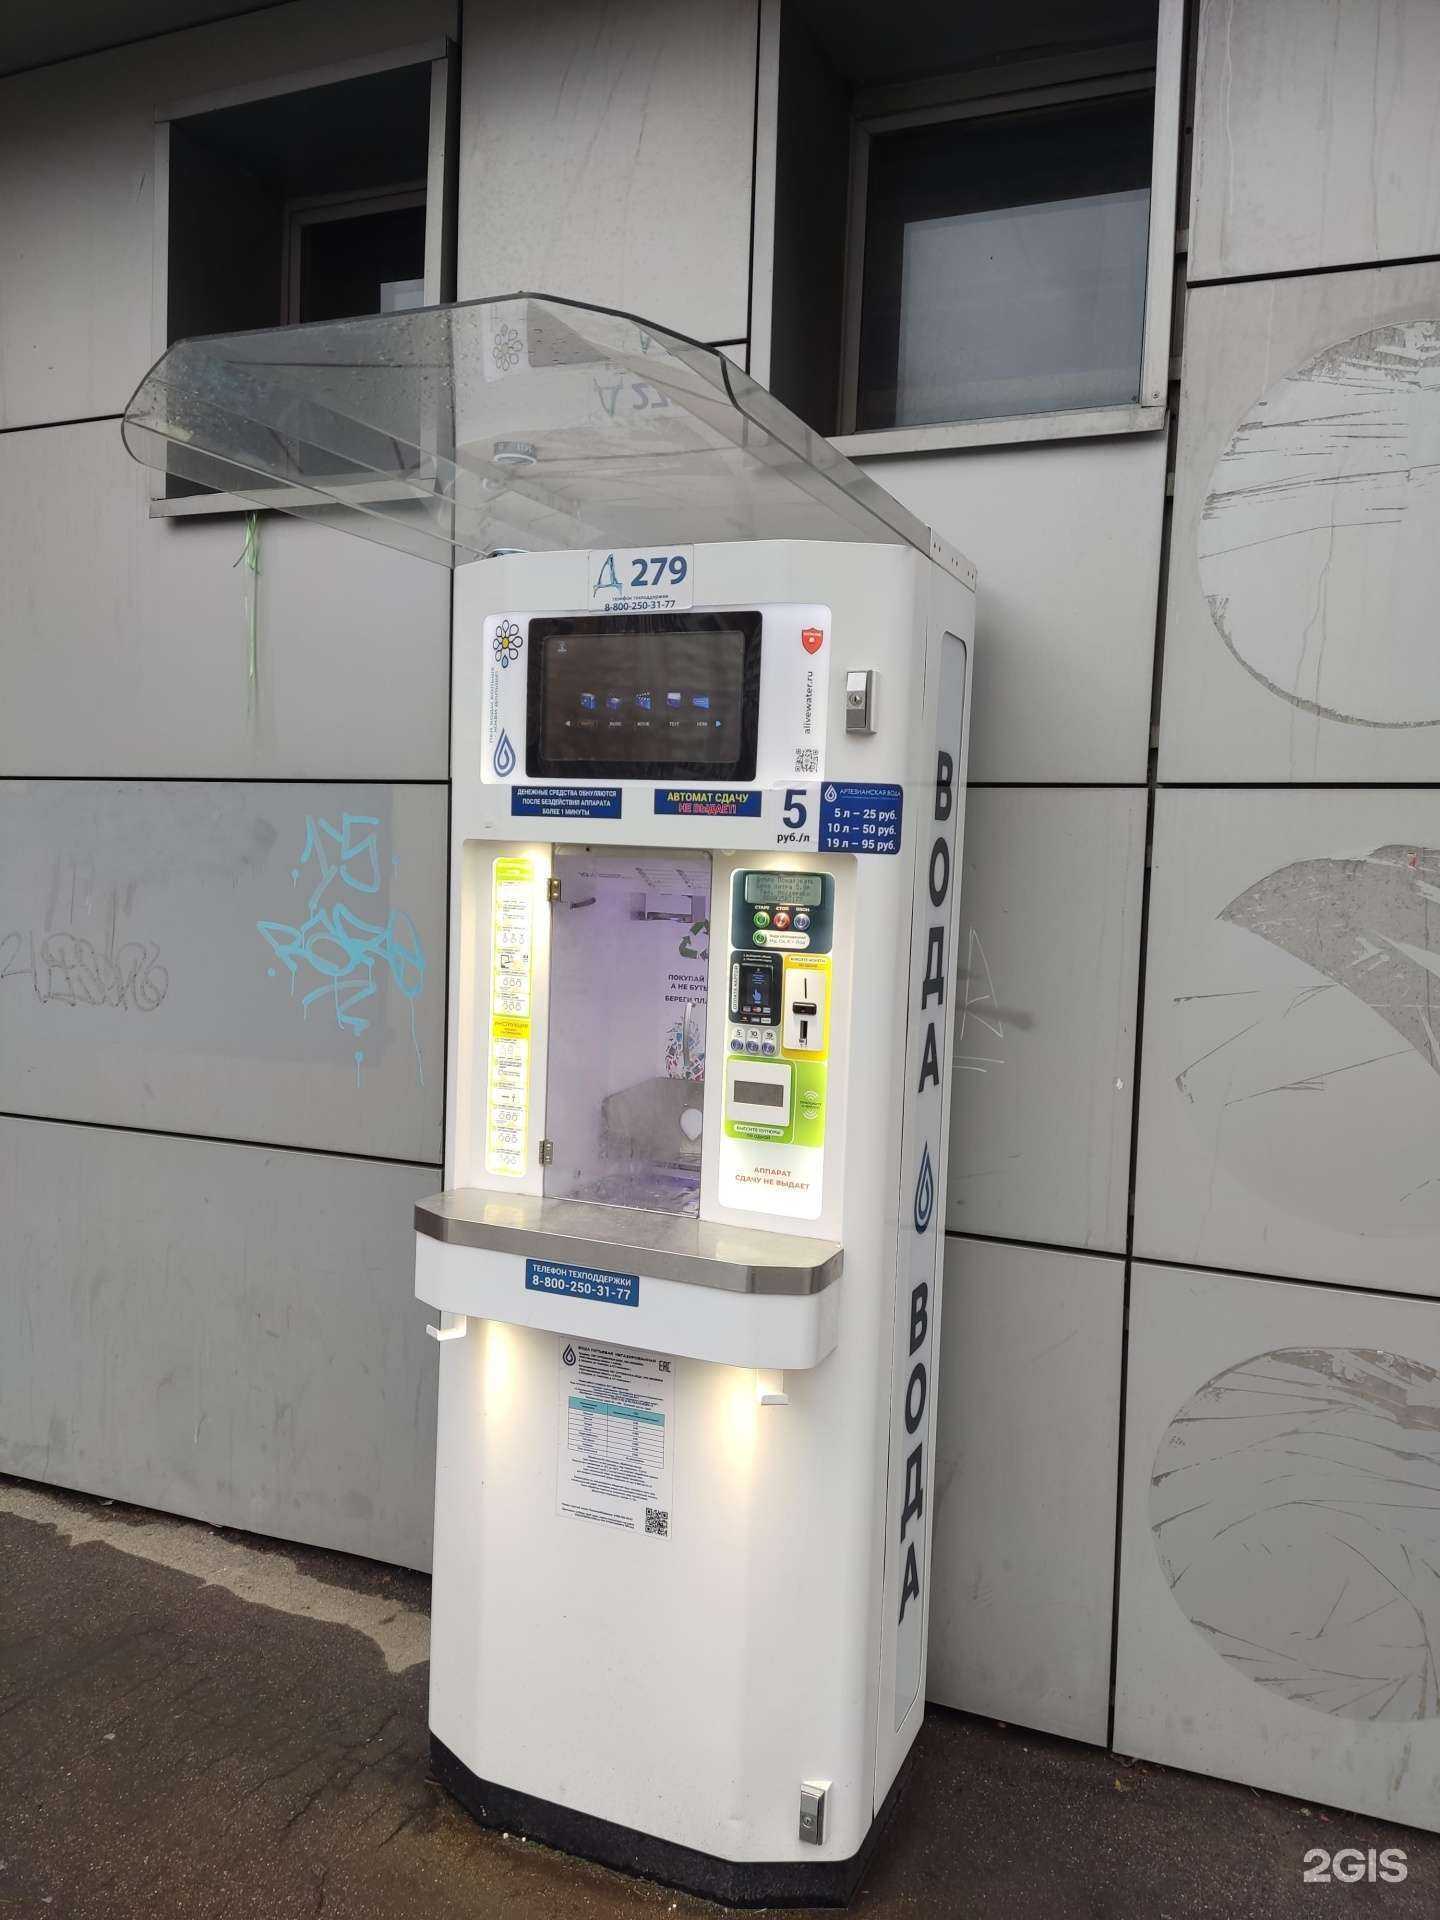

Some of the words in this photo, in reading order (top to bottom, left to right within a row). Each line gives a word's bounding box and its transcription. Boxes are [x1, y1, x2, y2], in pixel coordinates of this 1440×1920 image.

[631, 556, 687, 587] 279
[604, 600, 676, 611] 8-800-250-31-77
[804, 671, 813, 734] alivewater.ru
[517, 788, 548, 796] ДЕНЕЖНЫЕ
[549, 789, 578, 798] СРЕДСТВА
[579, 790, 616, 798] ОБНУЛЯЮТСЯ
[667, 792, 713, 802] АВТОМАТ
[715, 793, 748, 803] СДАЧУ
[678, 802, 692, 813] НЕ
[782, 789, 807, 829] 5
[834, 808, 840, 818] 5
[864, 809, 876, 818] 25
[879, 810, 897, 821] руб.
[828, 824, 840, 832] 10
[862, 824, 876, 834] 50
[878, 825, 896, 836] руб.
[777, 832, 810, 844] руб./л
[827, 838, 840, 848] 19
[862, 840, 874, 848] 95
[877, 840, 896, 852] руб.
[918, 750, 954, 1094] ВОДА
[754, 1168, 791, 1176] АППАРАТ
[735, 1174, 762, 1184] СДАЧУ
[776, 1180, 810, 1190] ВЫДАЕТ
[532, 1264, 566, 1276] ТЕЛЕФОН
[568, 1270, 631, 1286] ТЕХПОДДЕРЖКИ
[532, 1275, 630, 1300] 8-800-250-31-77
[898, 1281, 928, 1626] ВОДА
